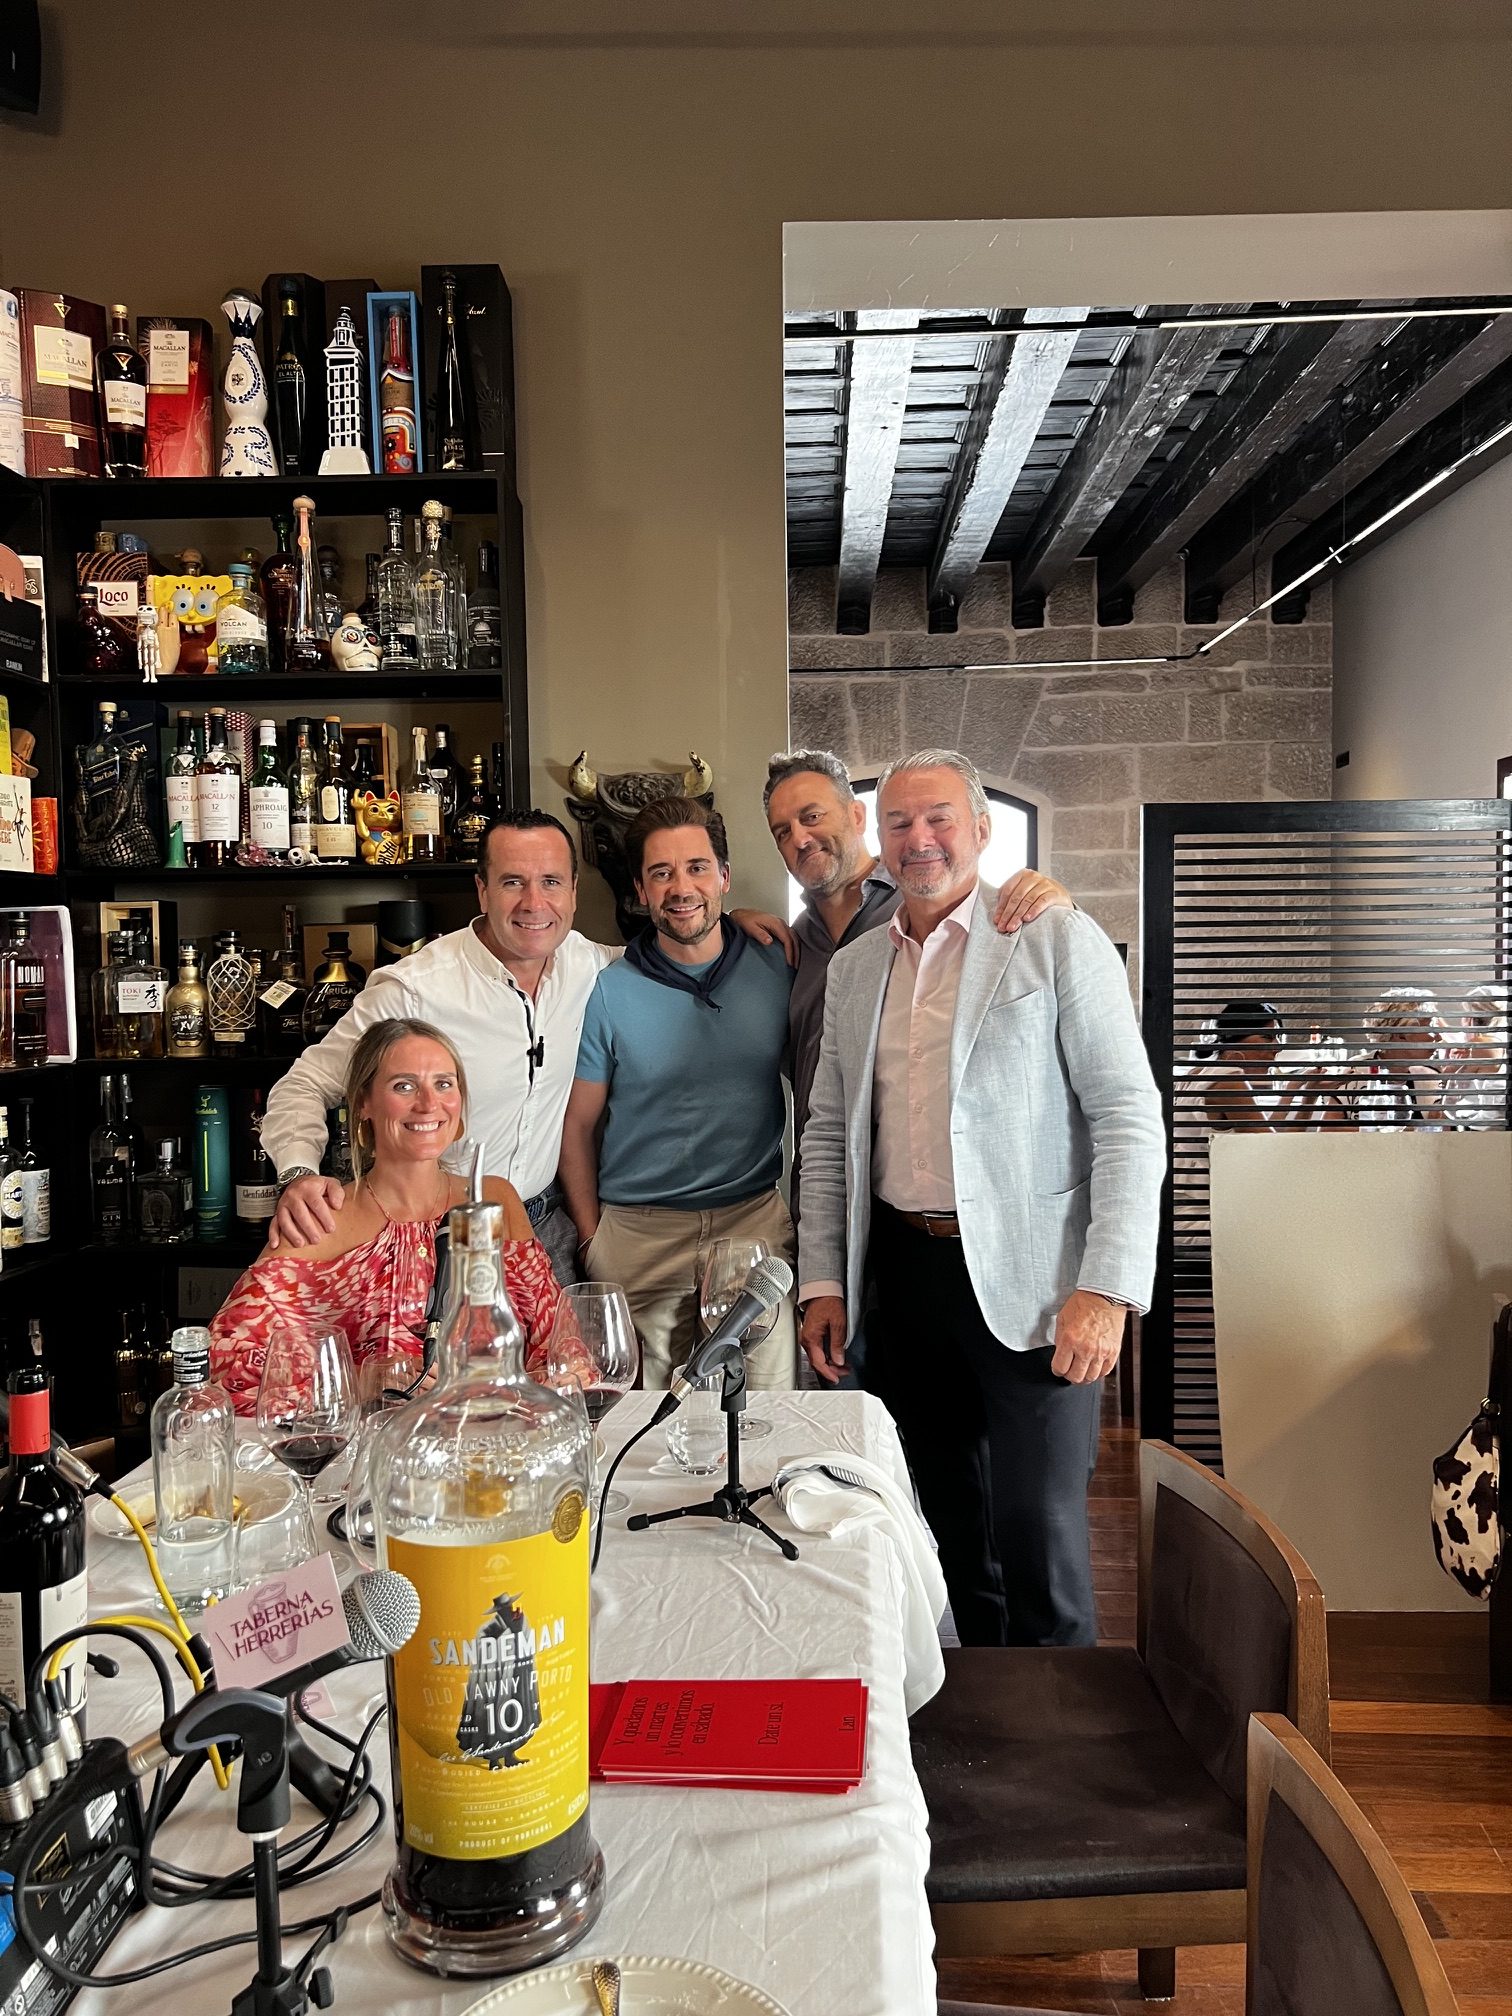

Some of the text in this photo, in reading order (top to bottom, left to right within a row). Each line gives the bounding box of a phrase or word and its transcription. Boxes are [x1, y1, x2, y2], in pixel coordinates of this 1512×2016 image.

[111, 397, 141, 406] MACALLAN
[168, 794, 201, 802] MACALLA
[212, 803, 220, 811] 12
[250, 803, 288, 812] APHROAIG
[262, 821, 273, 830] 10
[180, 1020, 195, 1031] XV
[253, 1149, 267, 1161] 15
[243, 1189, 277, 1199] Glenfiddich
[230, 1590, 315, 1638] TABERNA
[234, 1599, 335, 1658] HERRERÍAS
[428, 1616, 566, 1667] SANDEMAN
[422, 1664, 574, 1707] OLD TAWNY PORTO
[484, 1698, 524, 1736] 10
[767, 1712, 783, 1723] un
[691, 1733, 708, 1744] en
[757, 1724, 781, 1745] Date
[612, 1737, 635, 1745] Y
[458, 1822, 554, 1849] PRODUCT OF PORTUGAL
